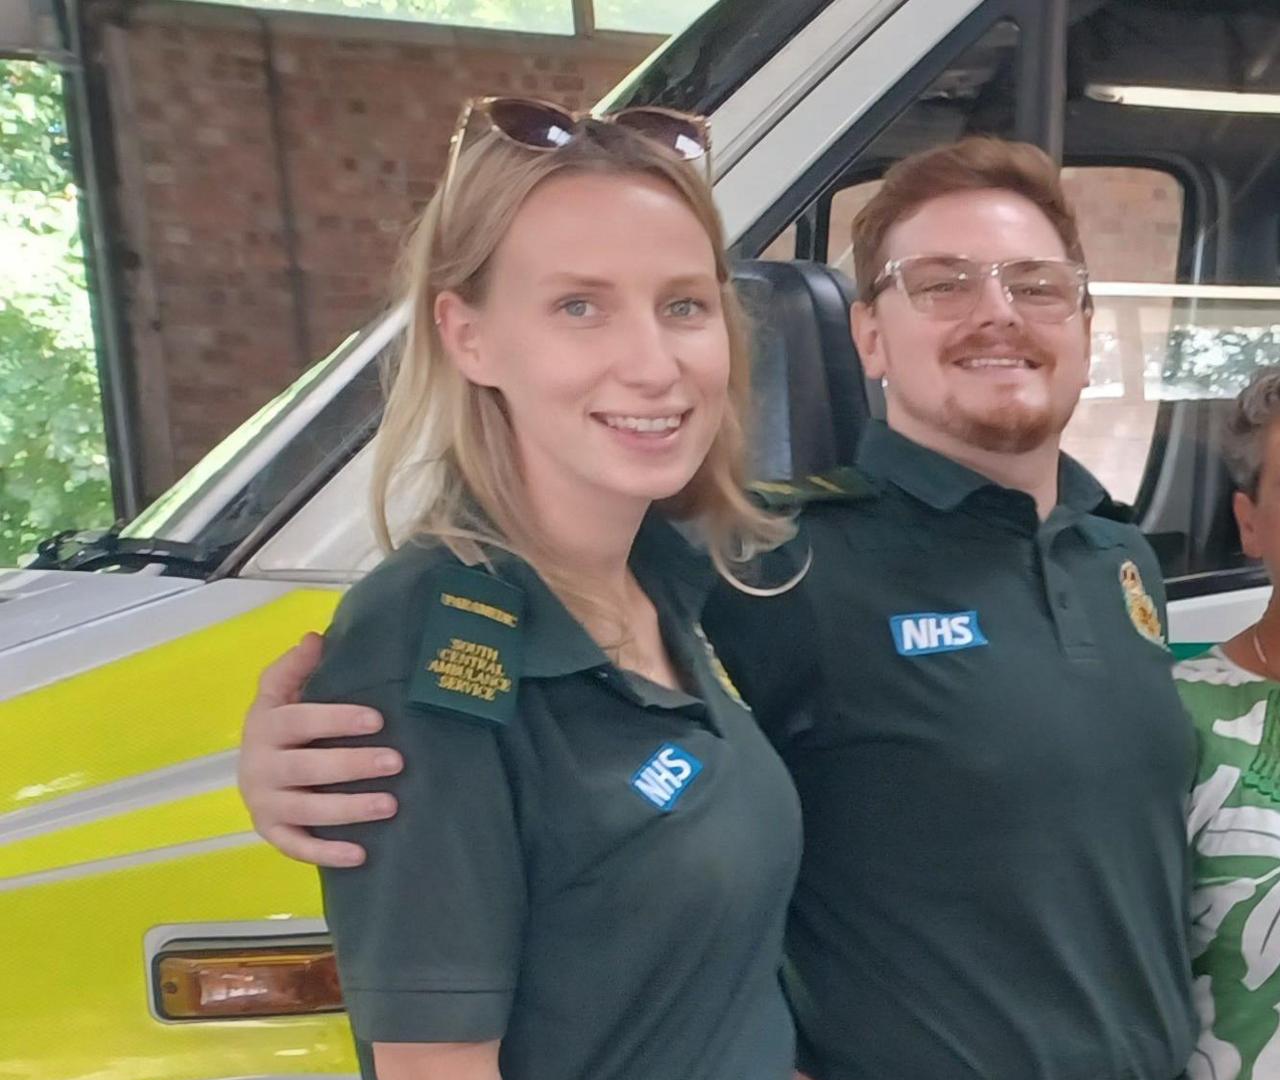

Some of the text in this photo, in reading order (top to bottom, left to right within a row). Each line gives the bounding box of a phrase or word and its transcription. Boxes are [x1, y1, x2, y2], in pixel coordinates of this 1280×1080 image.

[901, 615, 973, 650] NHS
[438, 648, 505, 677] CENTRAL
[448, 638, 499, 662] SOUTH
[425, 660, 512, 693] AMBULANCE
[437, 675, 497, 701] SERVICE
[634, 747, 692, 807] NHS
